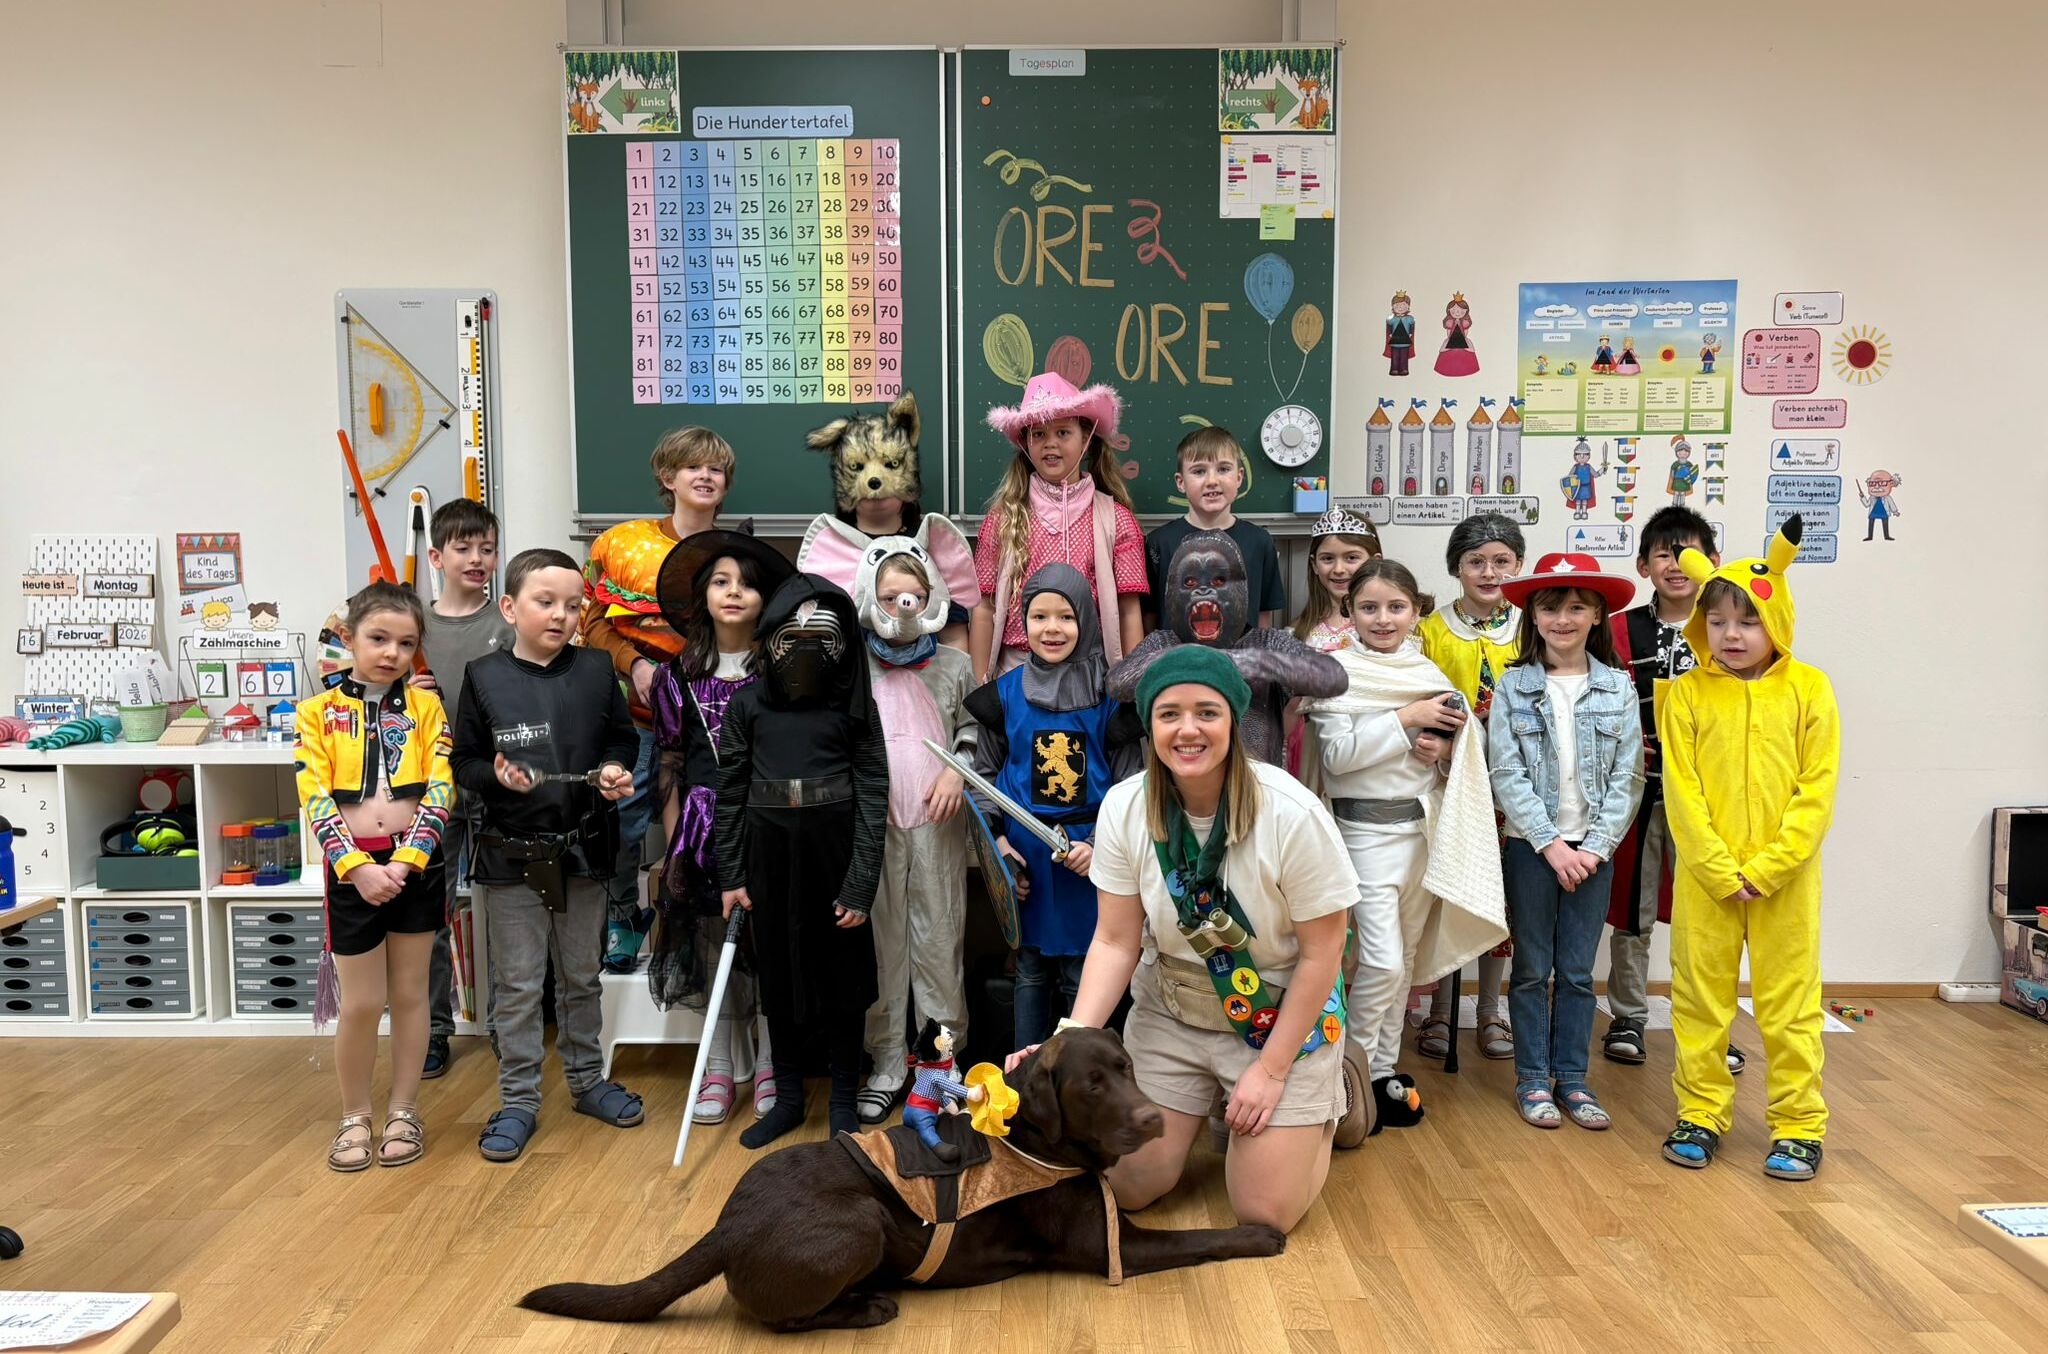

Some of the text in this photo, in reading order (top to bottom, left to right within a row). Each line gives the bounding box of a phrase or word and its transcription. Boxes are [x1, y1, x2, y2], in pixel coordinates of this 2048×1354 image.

[1019, 58, 1074, 70] Tagesplan
[640, 97, 666, 107] links
[1230, 96, 1262, 106] rechts
[697, 113, 849, 130] Die Hundertertafel
[636, 146, 895, 162] 1 2 3 4 5 6 7 8 9 10
[632, 172, 894, 189] 11 12 13 14 15 16 17 18 19 20
[993, 204, 1115, 288] ORE
[636, 277, 897, 296] 51 52 53 54 55 56 57 58 59 60
[637, 330, 897, 348] 71 72 73 74 75 76 77 78 79 80
[1768, 333, 1799, 342] Verben
[1115, 302, 1233, 386] ORE
[637, 383, 900, 398] 91 92 93 94 95 96 97 98 99 100
[1473, 435, 1483, 472] Menschen
[1437, 451, 1449, 472] Dinge
[1504, 452, 1513, 470] Tiere
[1774, 480, 1811, 491] Adjektive
[1426, 501, 1448, 509] haben
[1418, 511, 1446, 519] Artikel
[197, 556, 218, 567] Kind
[186, 568, 235, 581] des Tages
[22, 580, 50, 590] Heute
[53, 580, 65, 590] ist
[93, 580, 138, 592] Montag
[57, 629, 104, 640] Februar
[118, 628, 147, 640] 2026
[199, 637, 281, 648] Zählmaschine
[204, 673, 216, 694] 2
[245, 673, 285, 693] 6 9
[128, 682, 142, 705] Bella
[30, 703, 69, 713] Winter
[21, 783, 27, 793] 1
[39, 800, 47, 811] 2
[46, 822, 55, 834] 3
[41, 848, 48, 859] 4
[24, 865, 32, 876] 5
